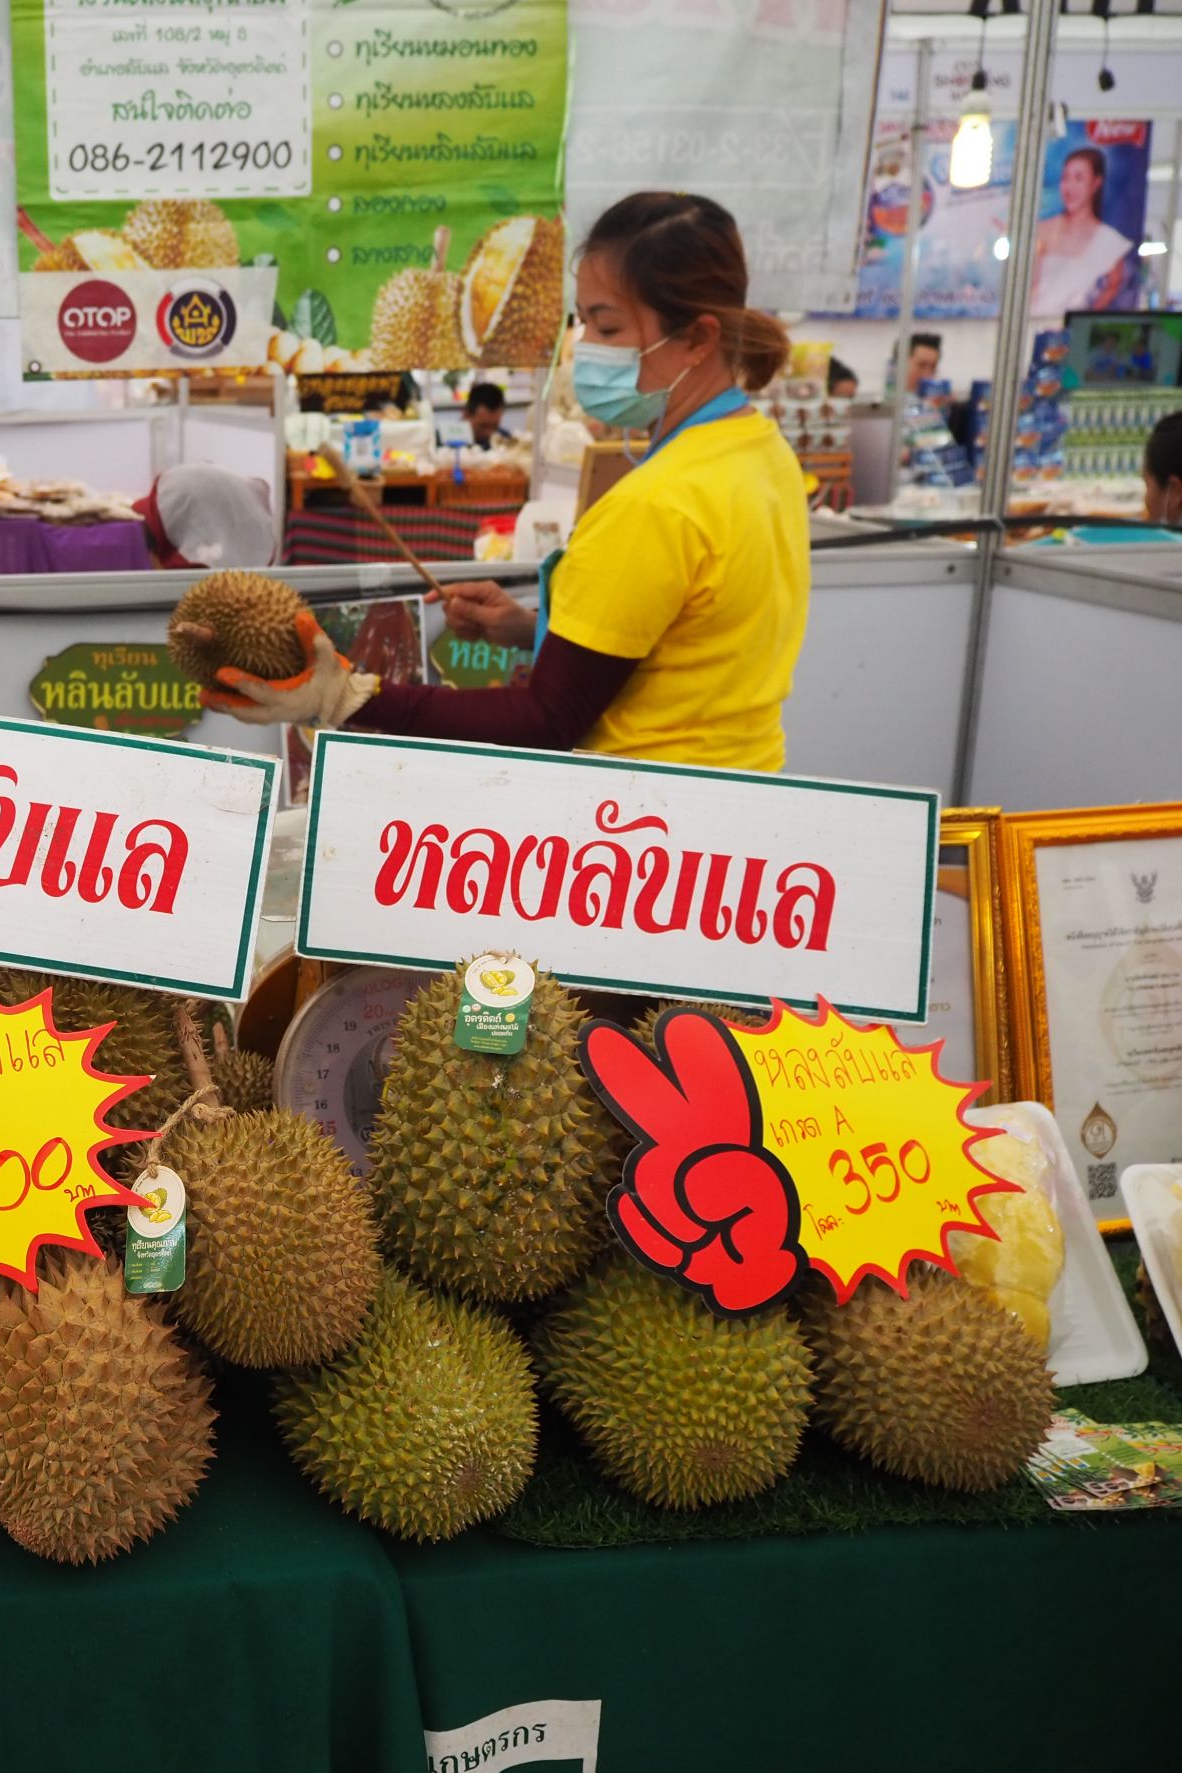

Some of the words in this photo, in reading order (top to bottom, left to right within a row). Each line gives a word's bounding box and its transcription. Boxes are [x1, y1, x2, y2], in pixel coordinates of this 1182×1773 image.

[355, 28, 538, 65] ทุเรียนหมอนทอง
[111, 87, 252, 122] สนใจติดต่อ
[355, 81, 536, 118] ทุเรียนหลงลับแล
[69, 140, 292, 172] 086-2112900
[354, 133, 538, 171] ทุเรียนหลินลับแล
[353, 195, 448, 214] ลองกอง
[63, 306, 131, 328] OTOP
[92, 647, 158, 671] ทุเรียน
[41, 670, 202, 709] หลินลับแล
[373, 799, 837, 952] หลงลับแล
[344, 1020, 357, 1032] 19
[363, 1003, 384, 1020] 20
[464, 1011, 502, 1026] อุตรดิตถ์
[327, 1044, 340, 1054] 18
[754, 1032, 917, 1090] หลงลับแล
[317, 1069, 329, 1080] 17
[315, 1100, 328, 1110] 16
[834, 1105, 855, 1135] A
[829, 1139, 931, 1215] 350
